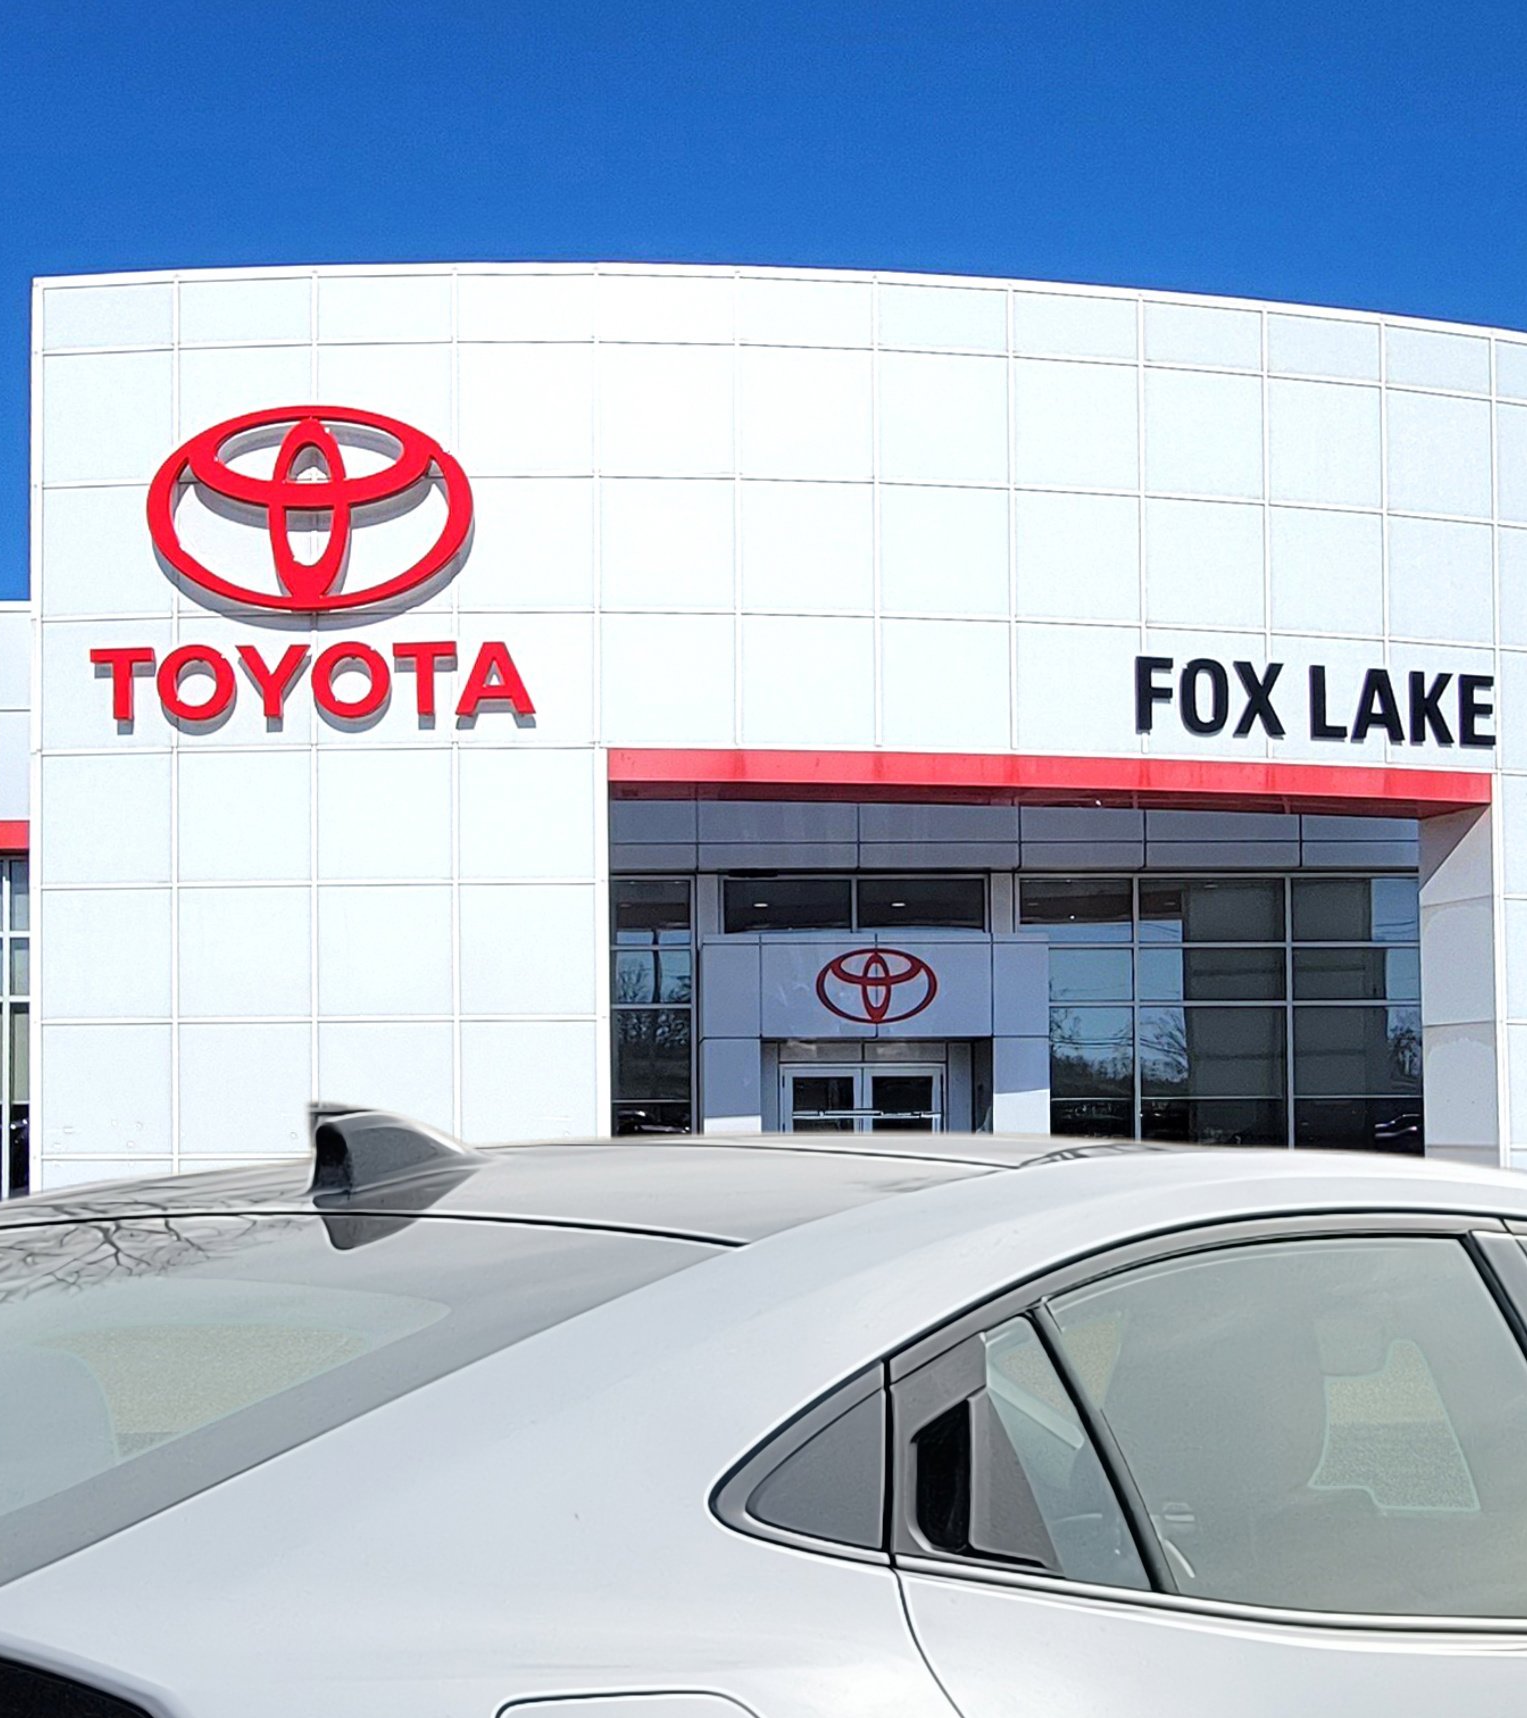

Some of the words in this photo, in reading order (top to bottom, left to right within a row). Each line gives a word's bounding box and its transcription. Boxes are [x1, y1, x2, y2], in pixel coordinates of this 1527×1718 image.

[90, 641, 537, 728] TOYOTA
[1135, 655, 1286, 739] FOX
[1308, 664, 1497, 748] LAKE
